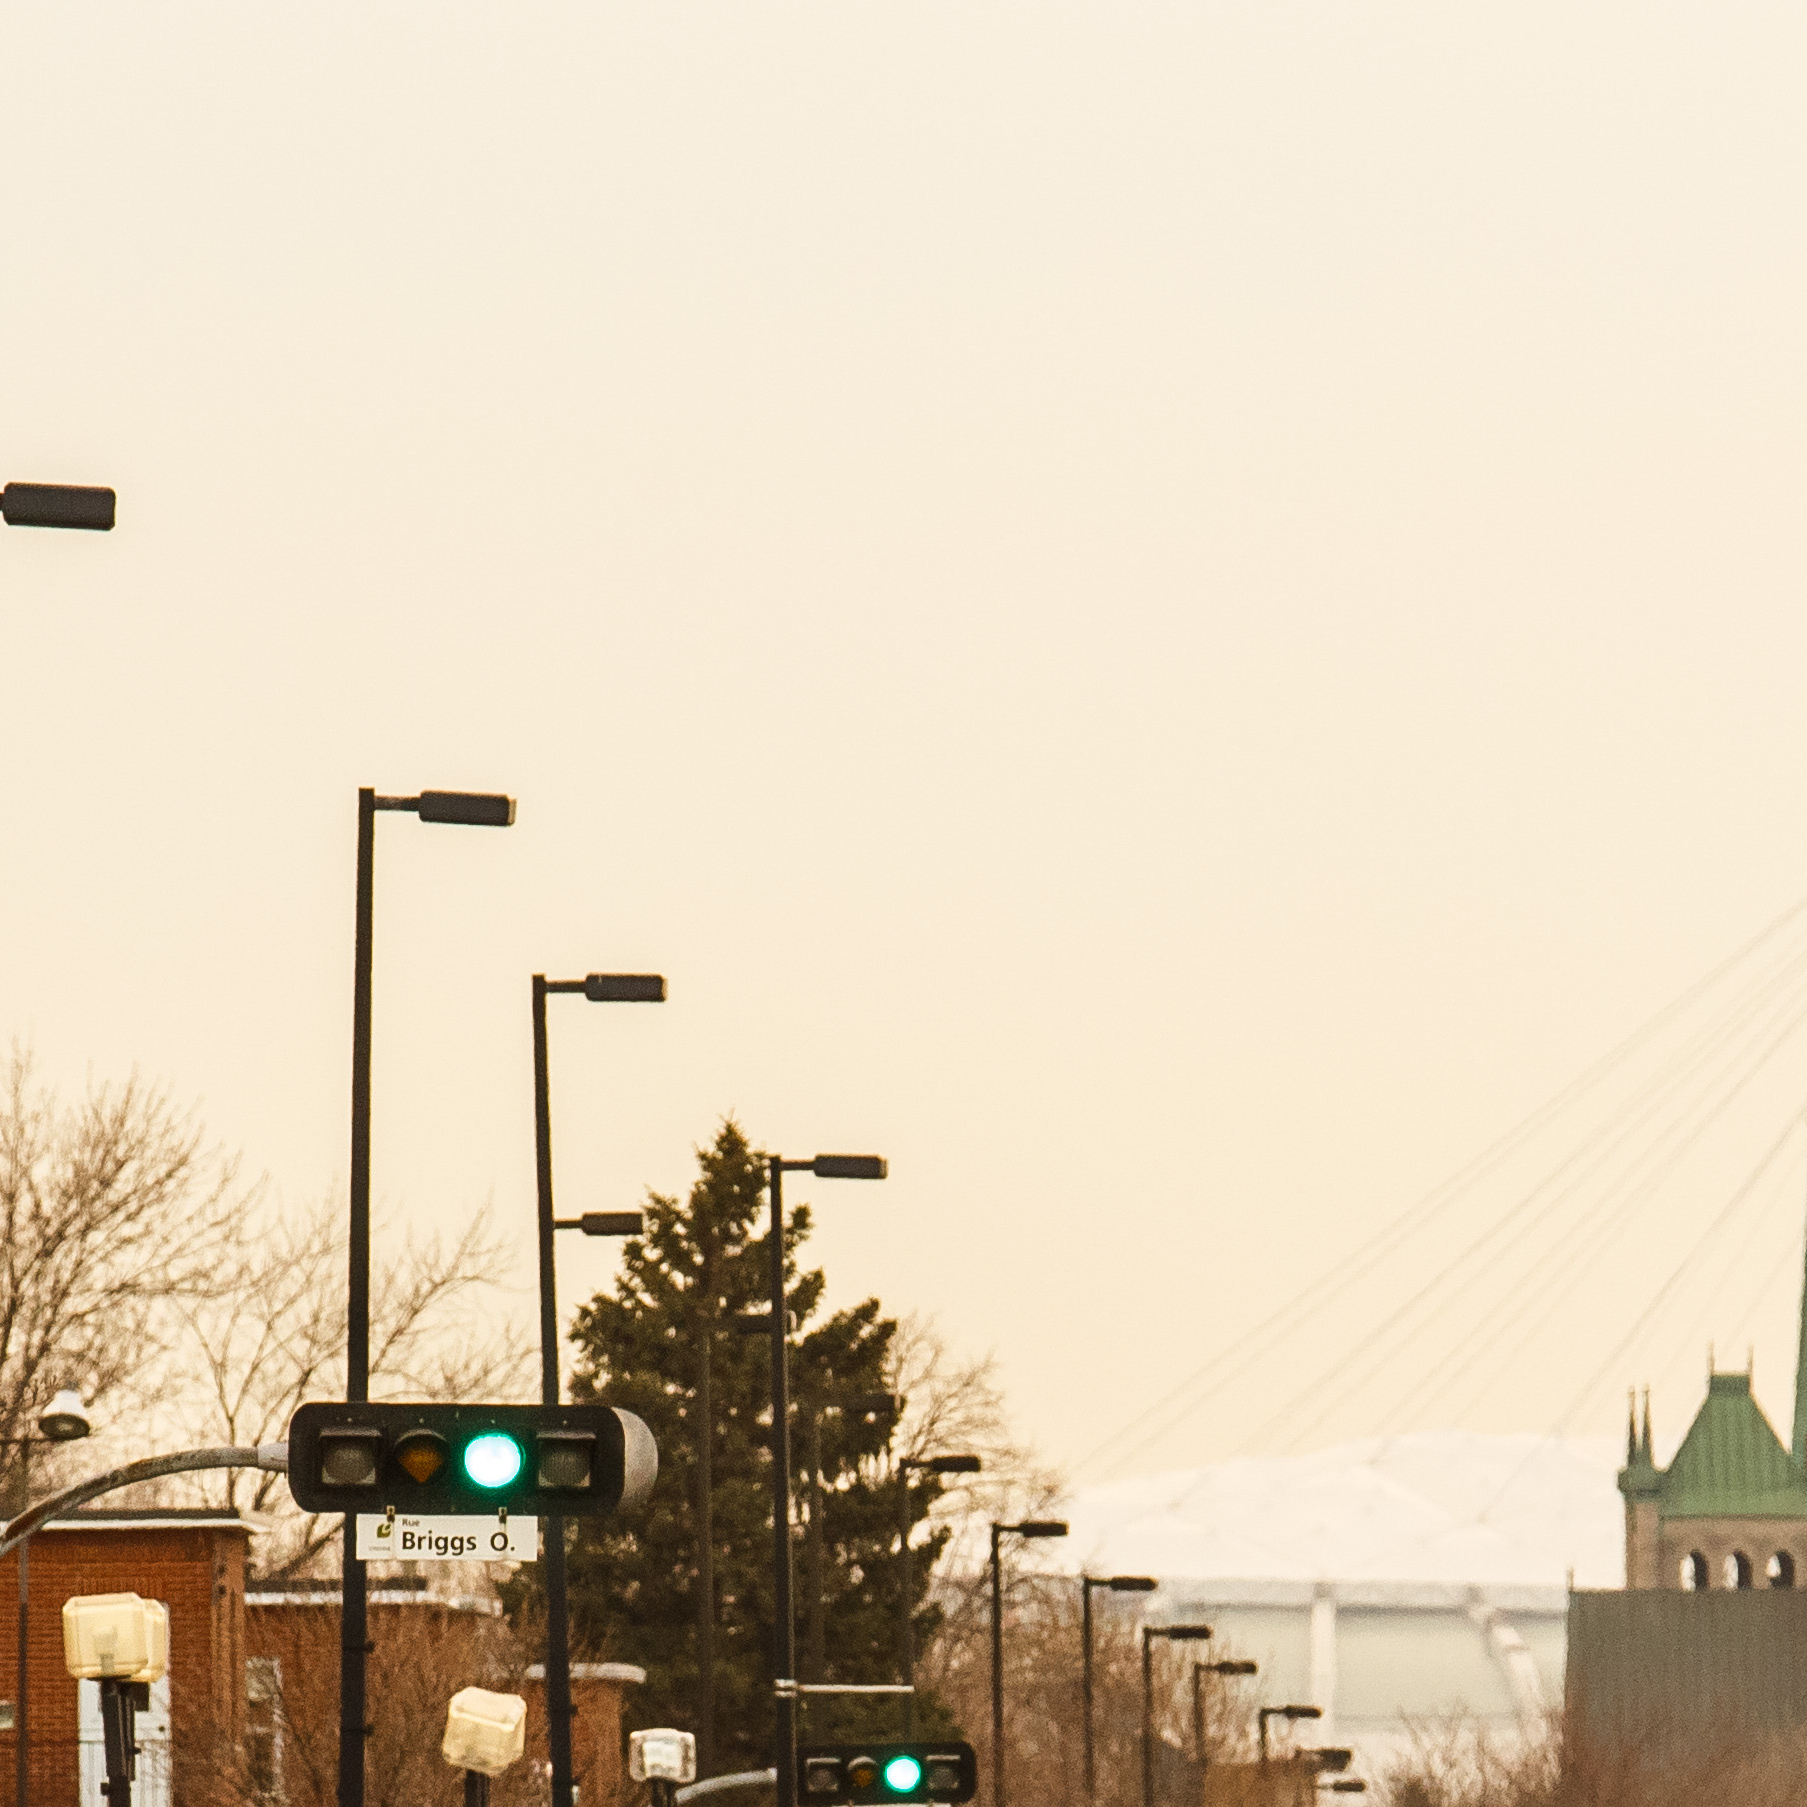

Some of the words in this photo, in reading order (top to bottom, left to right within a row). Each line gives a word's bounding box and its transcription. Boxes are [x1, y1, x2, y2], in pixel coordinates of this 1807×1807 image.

[401, 1517, 420, 1528] Rue
[401, 1530, 477, 1556] Briggs
[490, 1531, 515, 1552] O.
